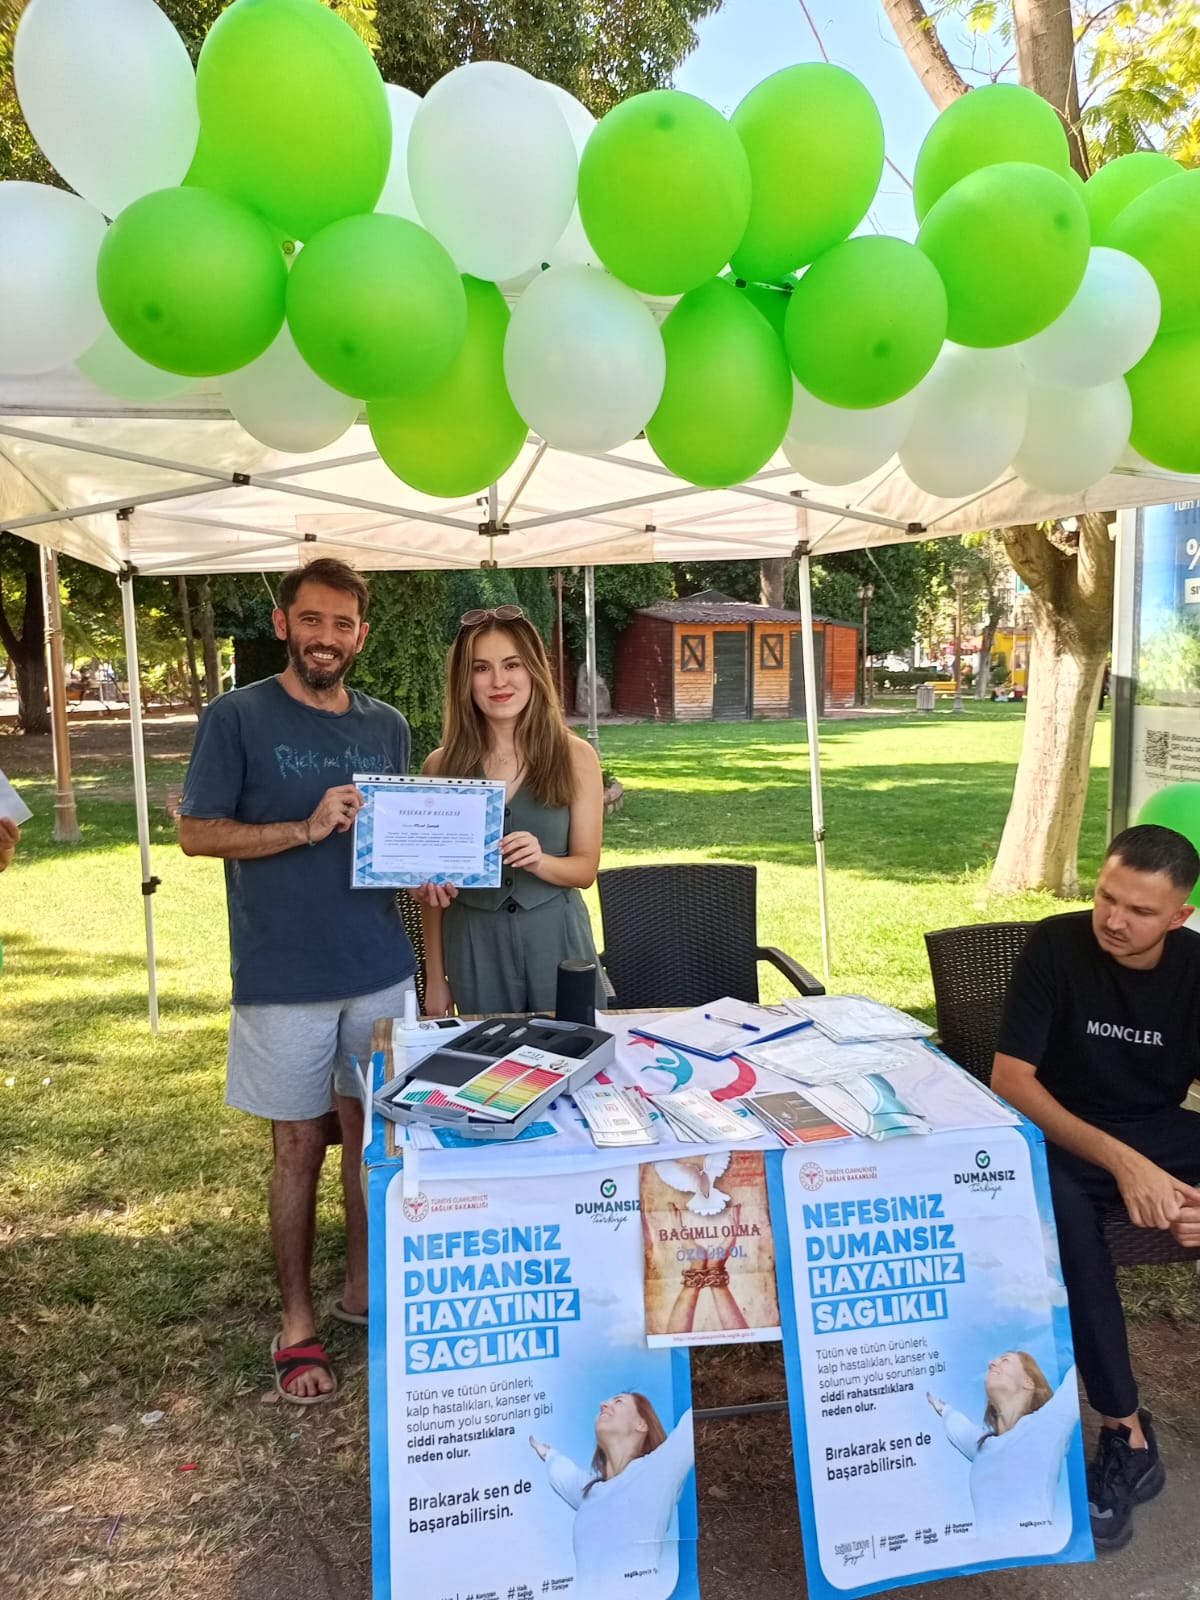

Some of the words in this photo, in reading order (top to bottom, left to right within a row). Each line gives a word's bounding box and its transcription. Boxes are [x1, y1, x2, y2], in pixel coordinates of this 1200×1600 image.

[1086, 1020, 1164, 1046] MONCLER
[954, 1170, 1016, 1184] DUMANSIZ
[575, 1200, 641, 1215] DUMANSIZ
[802, 1193, 945, 1229] NEFESİNİZ
[403, 1223, 561, 1262] NEFESİNİZ
[659, 1223, 718, 1242] BAĞIMLI
[722, 1223, 761, 1238] OLMA
[806, 1224, 956, 1262] DUMANSIZ
[729, 1245, 748, 1259] OL
[404, 1257, 572, 1298] DUMANSIZ
[811, 1255, 961, 1296] HAYATINIZ
[408, 1291, 576, 1332] HAYATINIZ
[816, 1347, 844, 1360] Tütün
[846, 1346, 858, 1356] ve
[860, 1342, 887, 1354] tütün
[817, 1362, 838, 1375] kalp
[895, 1352, 926, 1364] kanser
[928, 1350, 940, 1359] ve
[819, 1375, 862, 1389] solunum
[863, 1371, 884, 1385] yolu
[886, 1366, 927, 1379] sorunları
[929, 1361, 946, 1376] gibi
[406, 1389, 438, 1402] Tütün
[441, 1388, 455, 1399] ve
[458, 1383, 487, 1396] tütün
[490, 1376, 534, 1392] ürünleri;
[820, 1389, 845, 1403] ciddi
[847, 1382, 914, 1399] rahatsızlıklara
[406, 1405, 430, 1418] kalp
[433, 1399, 494, 1415] hastalıkları,
[496, 1393, 531, 1407] kanser
[533, 1390, 546, 1401] ve
[407, 1419, 455, 1433] solunum
[458, 1414, 482, 1430] yolu
[484, 1408, 532, 1424] sorunları
[534, 1402, 553, 1419] gibi
[821, 1405, 853, 1417] neden
[855, 1401, 877, 1413] olur.
[407, 1434, 435, 1449] ciddi
[438, 1426, 516, 1445] rahatsızlıklara
[825, 1438, 887, 1461] Bırakarak
[889, 1436, 912, 1450] sen
[915, 1432, 931, 1446] de
[407, 1450, 443, 1465] neden
[446, 1447, 471, 1460] olur.
[827, 1454, 917, 1481] başarabilirsin.
[409, 1488, 480, 1512] Bırakarak
[484, 1485, 510, 1500] sen
[513, 1479, 532, 1495] de
[409, 1504, 514, 1534] başarabilirsin.
